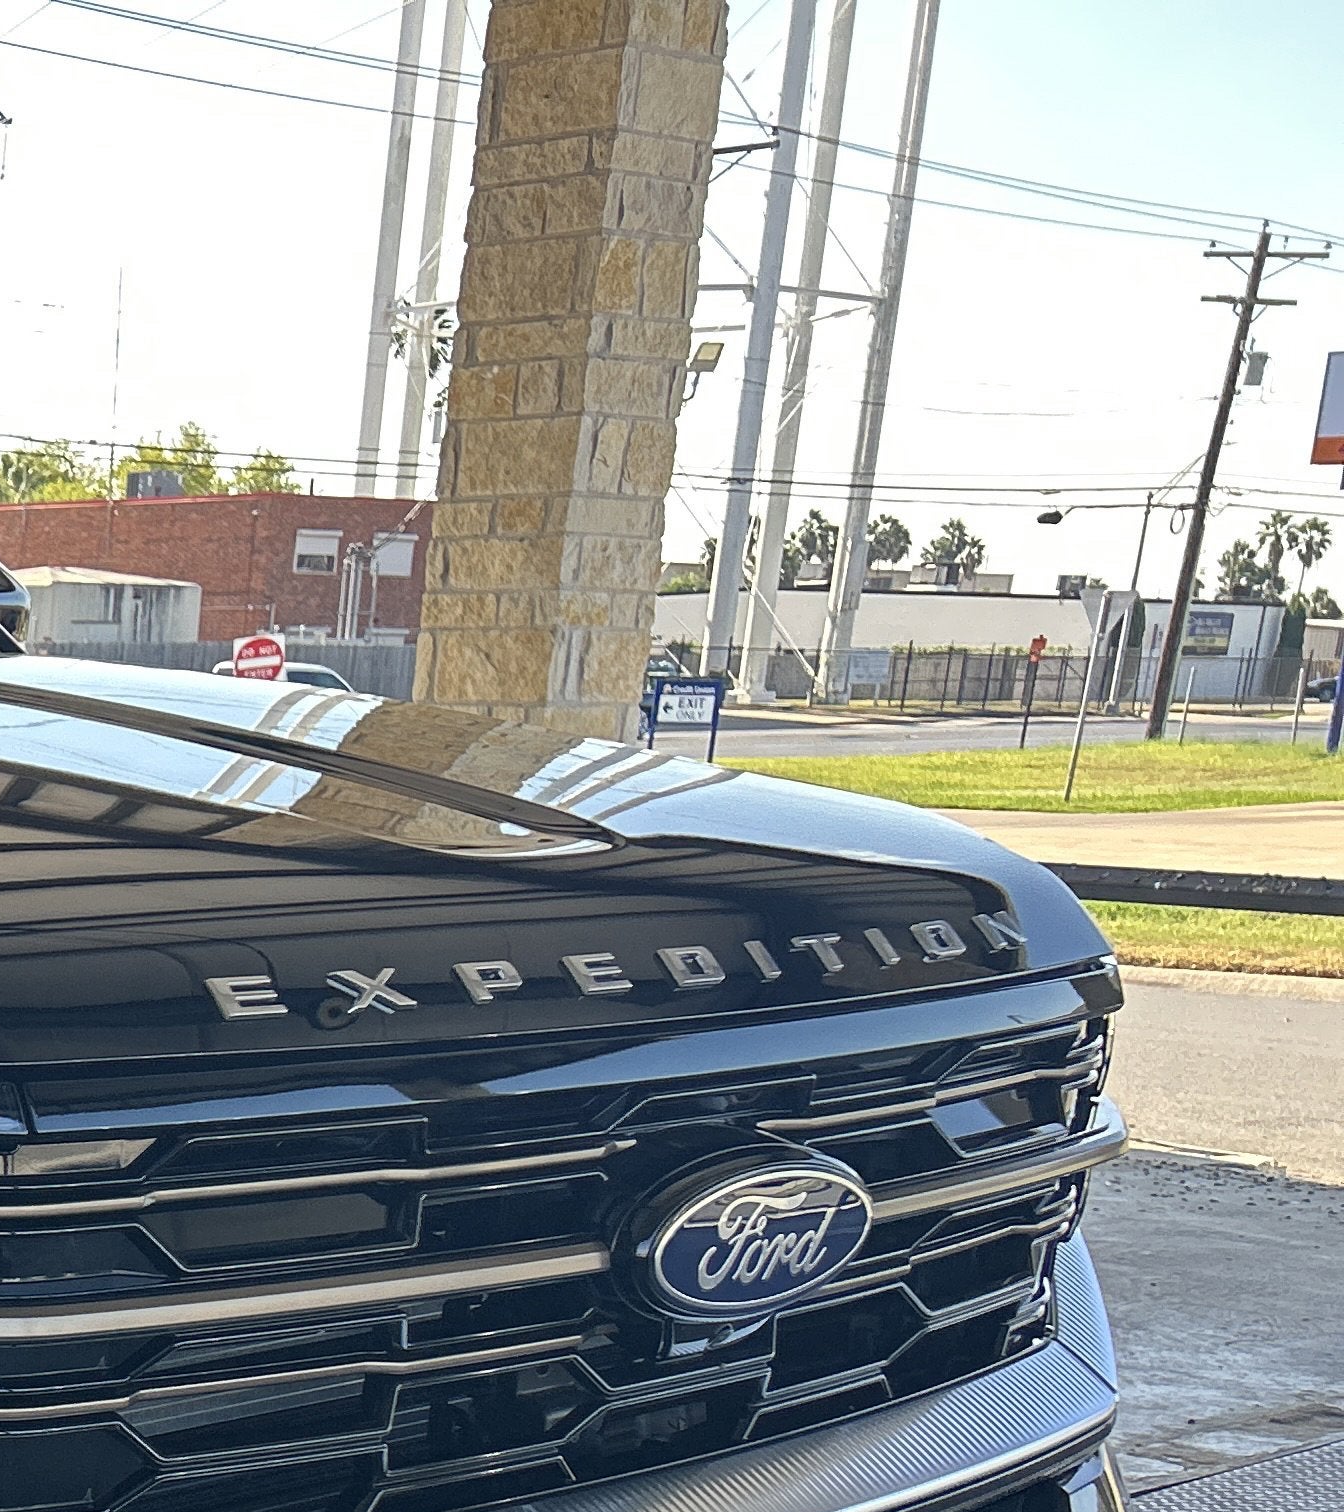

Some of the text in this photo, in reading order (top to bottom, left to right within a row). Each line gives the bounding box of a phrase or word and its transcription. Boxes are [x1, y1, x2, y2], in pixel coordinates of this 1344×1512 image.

[678, 696, 706, 709] EXIT
[205, 910, 1030, 1021] EXPEDITION
[698, 1191, 837, 1291] Ford
